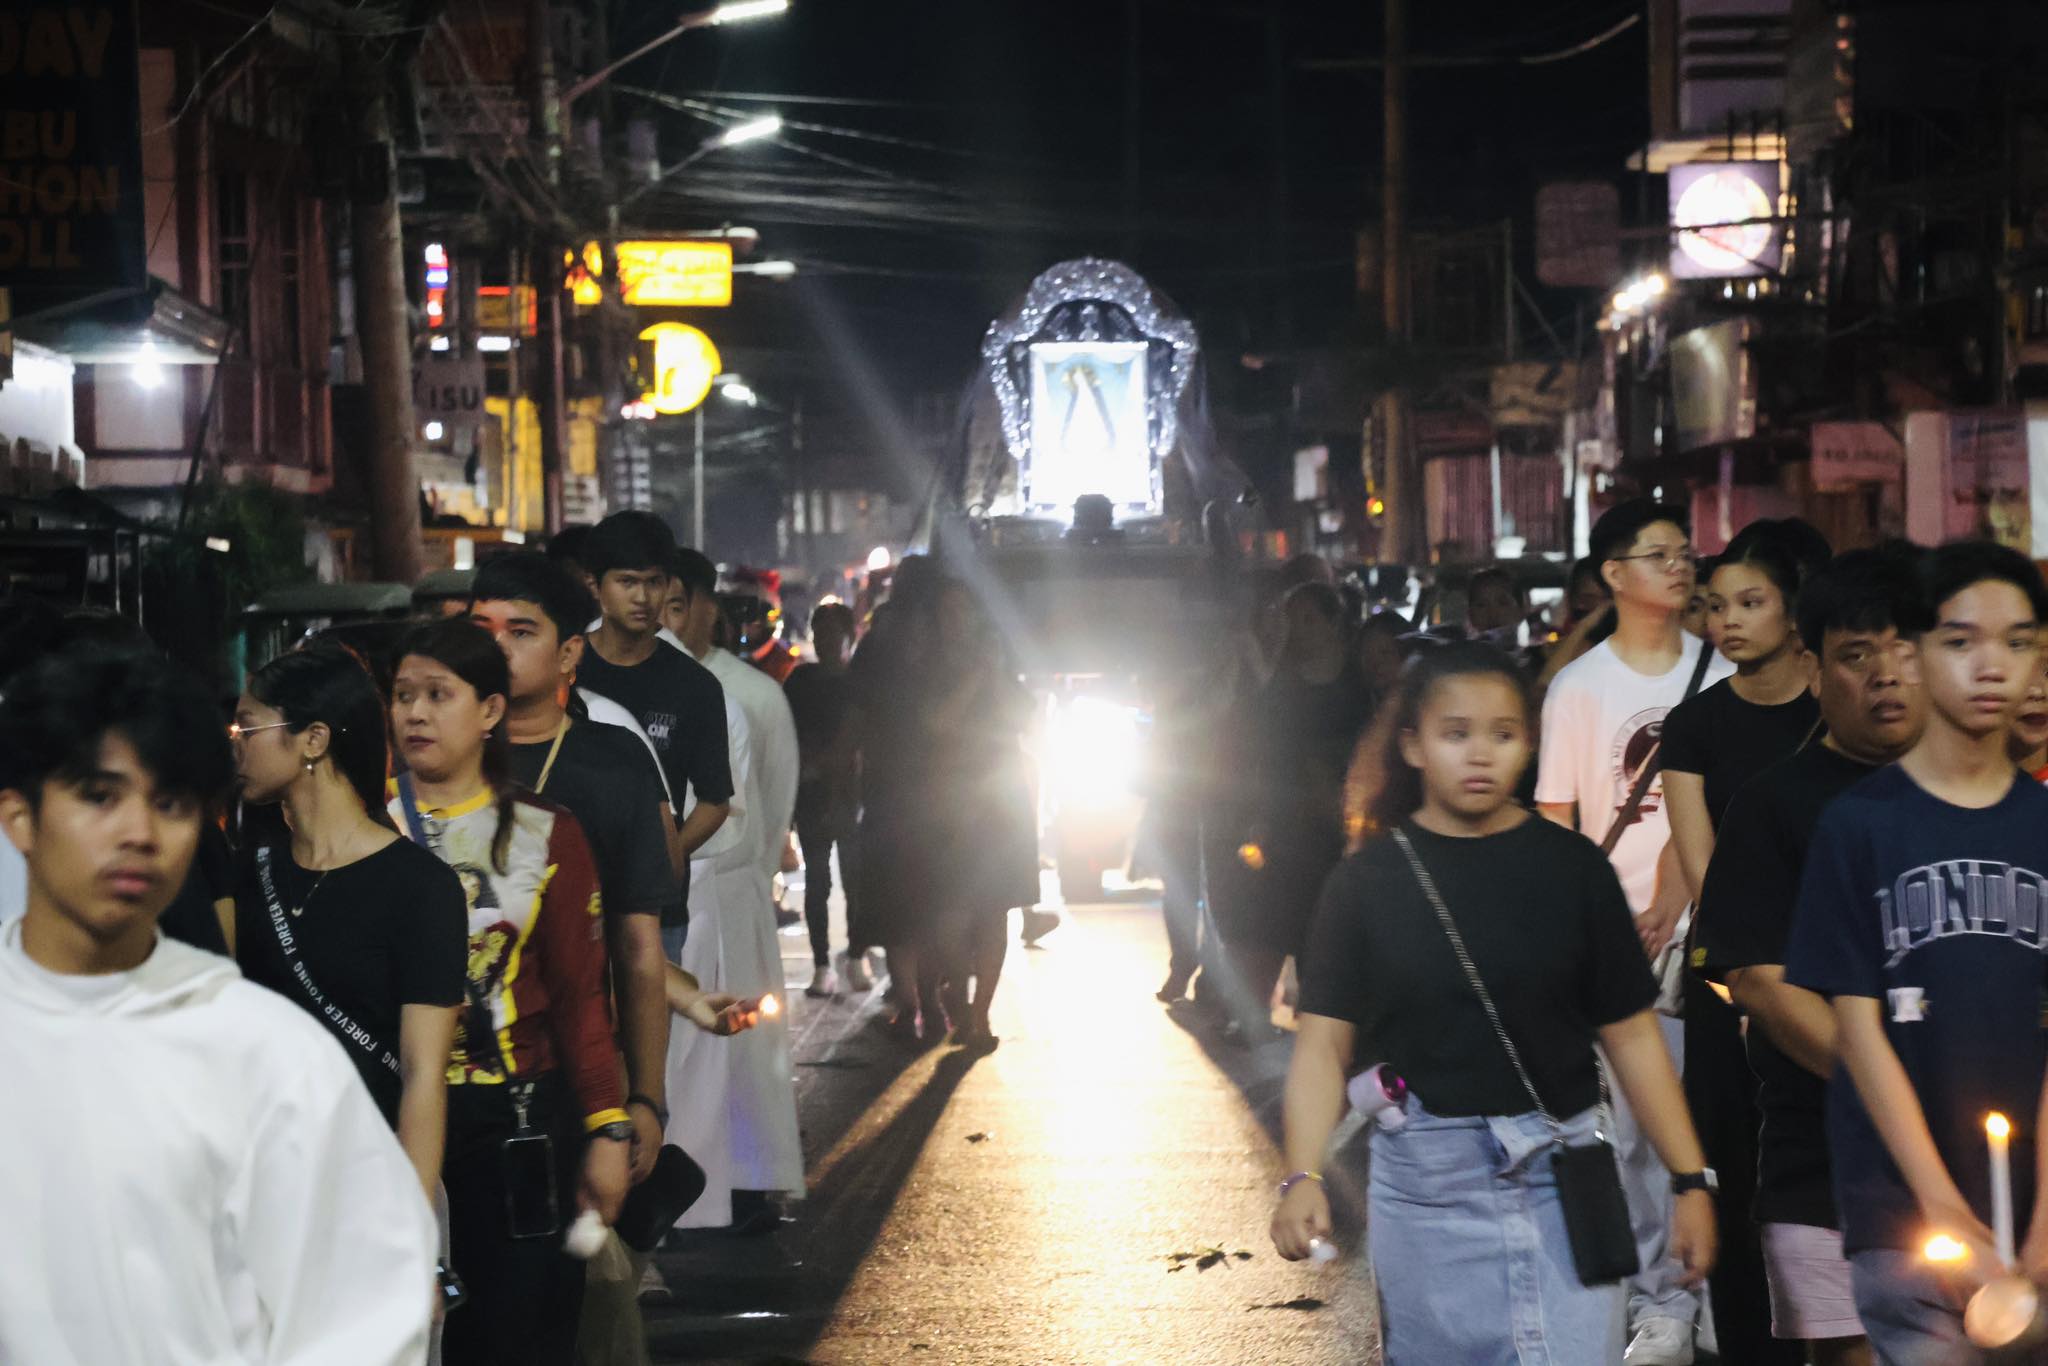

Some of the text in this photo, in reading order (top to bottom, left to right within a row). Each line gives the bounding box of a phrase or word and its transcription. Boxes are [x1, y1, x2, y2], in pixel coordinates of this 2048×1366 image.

[268, 901, 297, 955] FOREVER
[293, 960, 324, 1005] YOUNG
[324, 1003, 378, 1052] FOREVER
